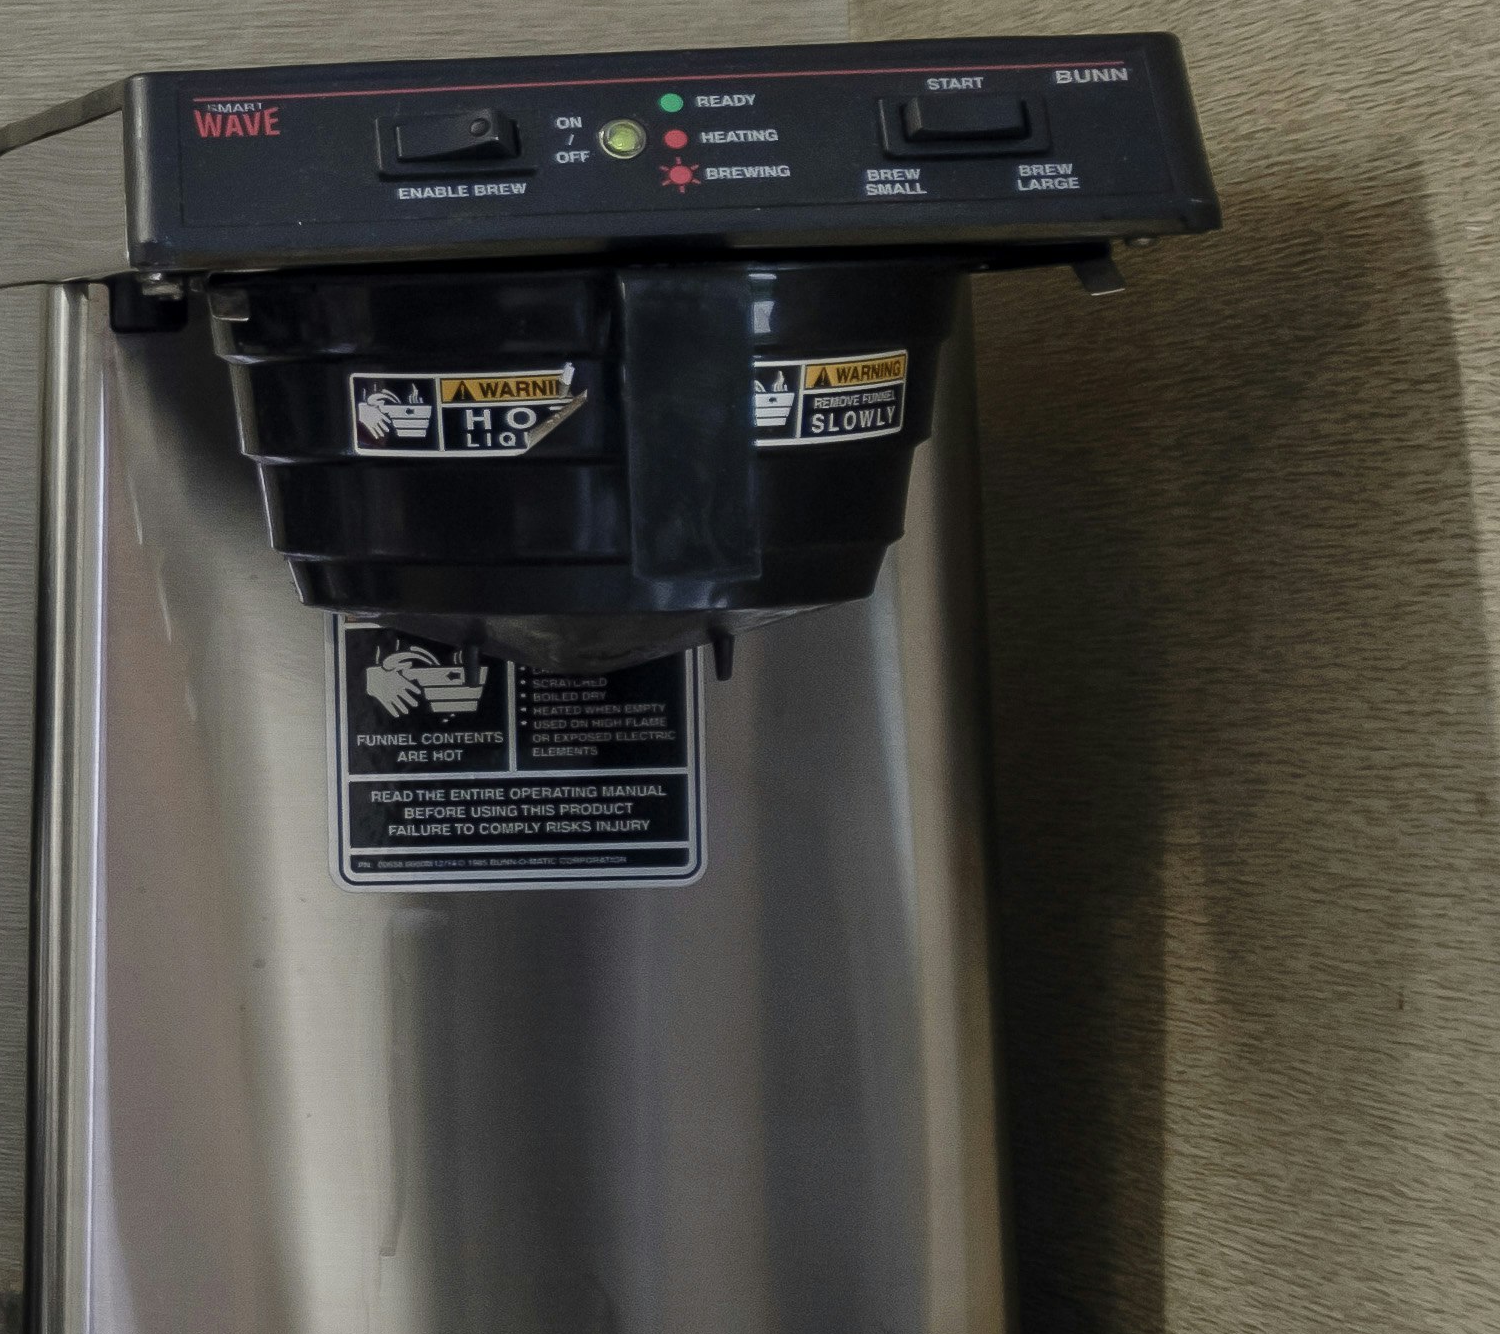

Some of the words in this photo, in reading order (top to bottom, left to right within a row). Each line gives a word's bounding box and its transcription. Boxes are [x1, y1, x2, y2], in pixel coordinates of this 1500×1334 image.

[1055, 68, 1128, 84] BUNN
[926, 77, 983, 90] START
[695, 94, 756, 108] READY
[193, 107, 281, 138] WAVE
[556, 117, 582, 129] ON
[700, 129, 778, 143] HEATING
[556, 151, 590, 164] OFF
[705, 165, 790, 180] BREWING
[866, 169, 920, 182] BREW
[1018, 163, 1073, 177] BREW
[397, 185, 469, 200] ENABLE
[474, 182, 527, 198] BREW
[866, 183, 927, 196] SMALL
[1017, 177, 1080, 191] LARGE
[836, 360, 901, 384] WARNING
[814, 394, 860, 409] REMOVE
[811, 406, 896, 433] SLOWLY
[533, 692, 578, 702] BOILED
[582, 691, 607, 701] DRY
[533, 705, 582, 715] HEATED
[585, 704, 621, 714] WHEN
[624, 703, 666, 713] EMPTY
[533, 719, 567, 729] USED
[591, 718, 622, 727] HIGH
[356, 734, 417, 746] FUNNEL
[421, 732, 504, 745] CONTENTS
[554, 732, 612, 742] EXPOSED
[616, 730, 676, 741] ELECTRIC
[397, 751, 428, 762] ARE
[433, 750, 463, 761] HOT
[532, 746, 598, 757] ELEMENTS
[371, 790, 414, 803] READ
[417, 789, 445, 802] THE
[450, 788, 504, 801] ENTIRE
[510, 787, 597, 800] OPERATING
[601, 785, 666, 798] MANUAL
[404, 807, 465, 819] BEFORE
[471, 805, 517, 818] USING
[520, 804, 555, 817] THIS
[559, 803, 633, 816] PRODUCT
[388, 824, 451, 837] FAILURE
[454, 823, 475, 835] TO
[479, 821, 540, 836] COMPLY
[546, 821, 591, 833] RISKS
[596, 819, 650, 833] INJURY
